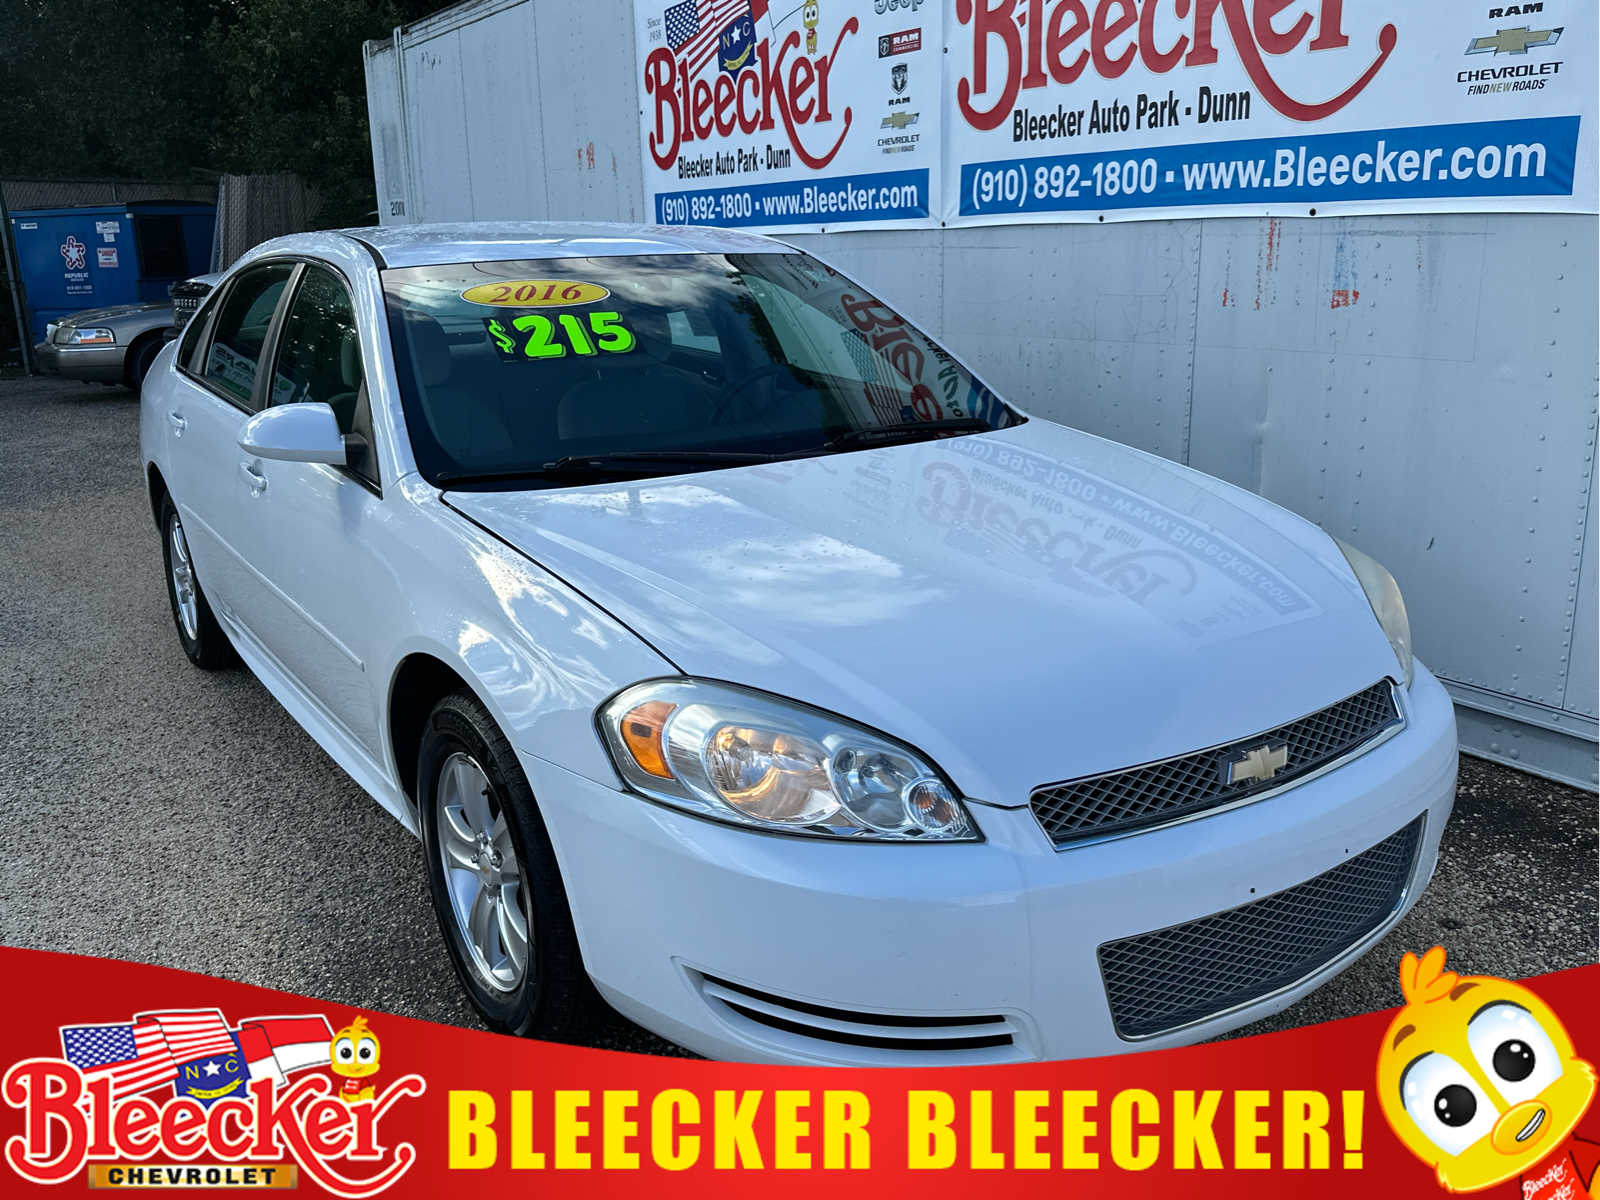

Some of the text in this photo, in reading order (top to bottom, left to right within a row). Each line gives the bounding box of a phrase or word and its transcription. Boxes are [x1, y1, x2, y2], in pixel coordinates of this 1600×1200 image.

[1488, 2, 1544, 19] RAM
[893, 32, 919, 45] RAM
[1457, 62, 1564, 83] CHEVROLET
[645, 16, 859, 170] Bleecker
[888, 97, 911, 106] RAM
[1012, 86, 1251, 142] Bleecker Auto Park Dunn
[877, 134, 920, 146] CHEVROLET
[678, 144, 791, 179] Bleecker Auto Park Dunn
[972, 141, 1546, 210] (910) 892-1800 www.Bleecker.com
[662, 182, 919, 225] (910) 892-1800 www.Bleecker.com
[488, 284, 583, 303] 2016
[487, 311, 637, 360] $215
